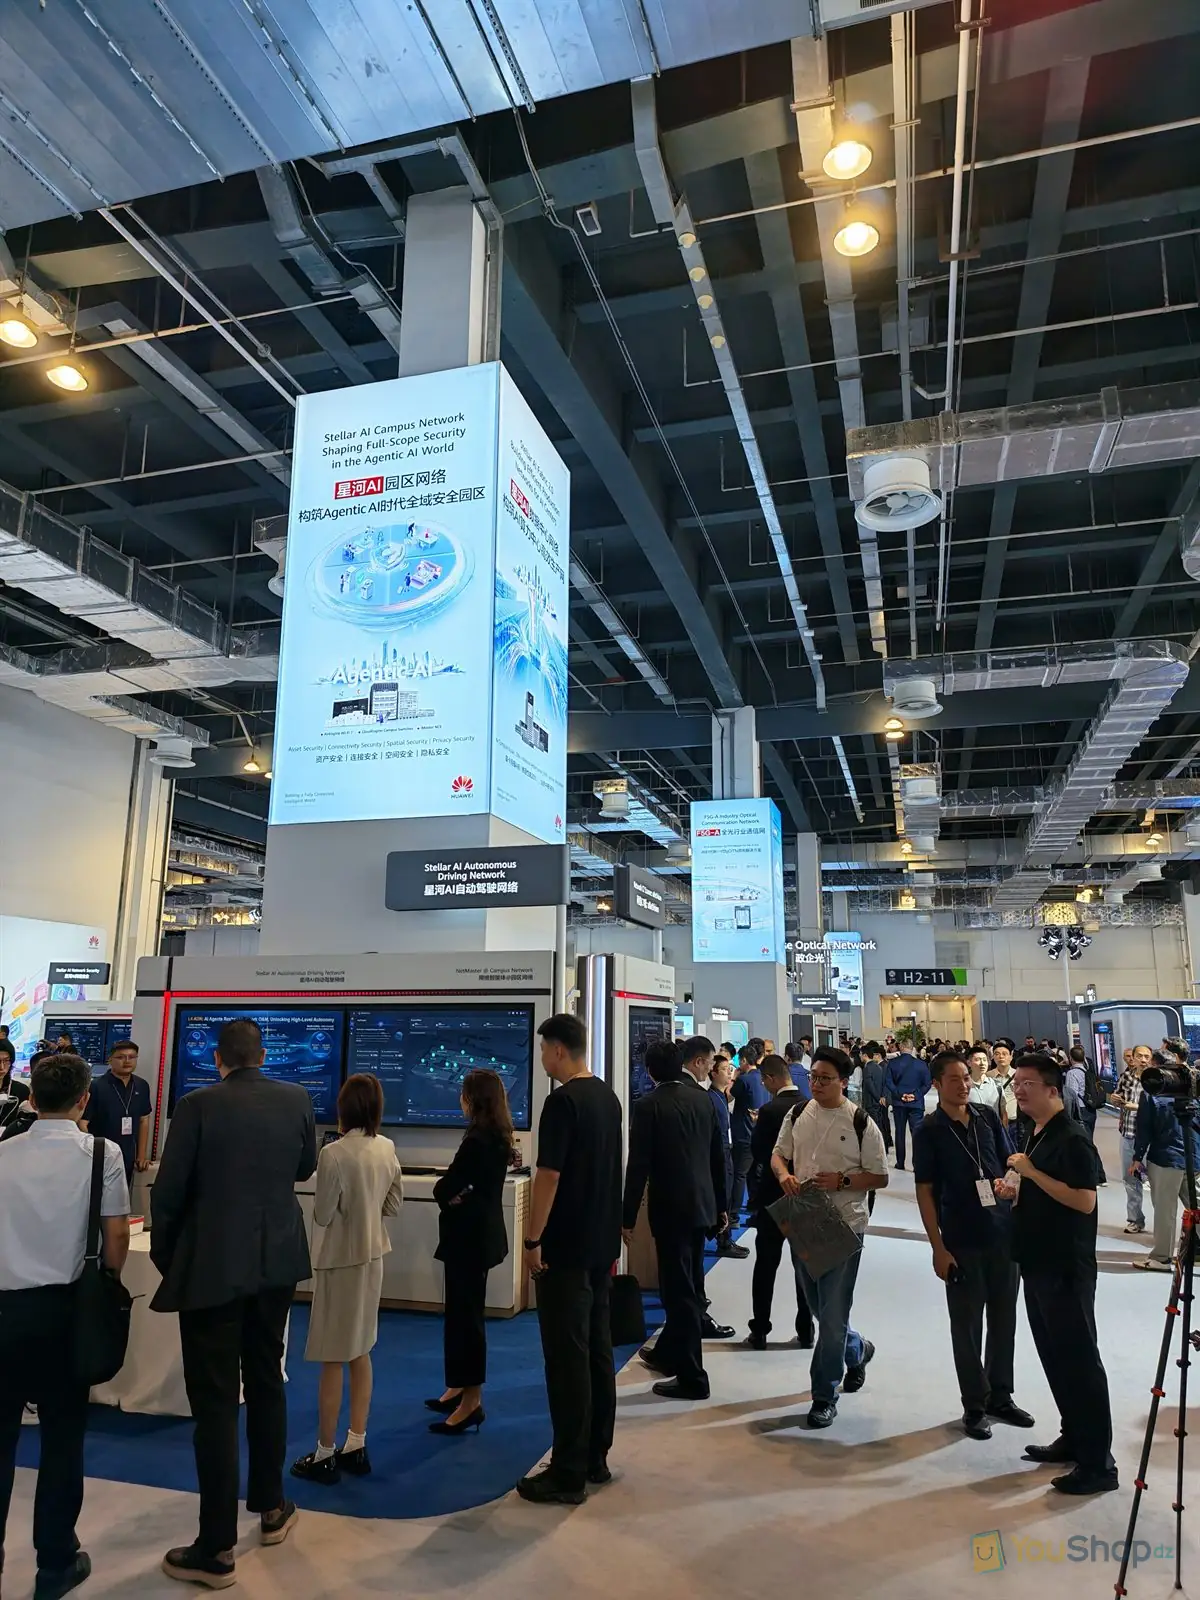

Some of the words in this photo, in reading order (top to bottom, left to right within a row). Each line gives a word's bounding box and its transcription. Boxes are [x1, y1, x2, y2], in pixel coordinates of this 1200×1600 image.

[324, 430, 357, 443] Stellar
[359, 427, 371, 437] AI
[374, 421, 416, 435] Campus
[419, 412, 465, 428] Network
[322, 443, 363, 457] Shaping
[366, 435, 420, 450] Full-Scope
[423, 427, 467, 442] Security
[331, 459, 342, 469] in
[344, 457, 362, 467] the
[364, 450, 404, 466] Agentic
[406, 447, 418, 458] AI
[421, 442, 455, 456] World
[336, 479, 382, 498] 星河AI
[385, 469, 447, 491] 园区网络
[332, 662, 406, 688] Agentic
[411, 659, 434, 680] AI
[432, 736, 452, 744] Privacy
[315, 754, 344, 764] 资产安全
[385, 750, 414, 759] 空间安全
[424, 862, 452, 872] Stellar
[453, 862, 463, 871] AI
[464, 861, 517, 870] Autonomous
[437, 871, 468, 882] Driving
[469, 870, 506, 880] Network
[424, 881, 519, 896] 星河AI自动驾驶网络
[795, 940, 831, 951] Optical
[832, 940, 877, 950] Network
[903, 971, 945, 984] H2-11
